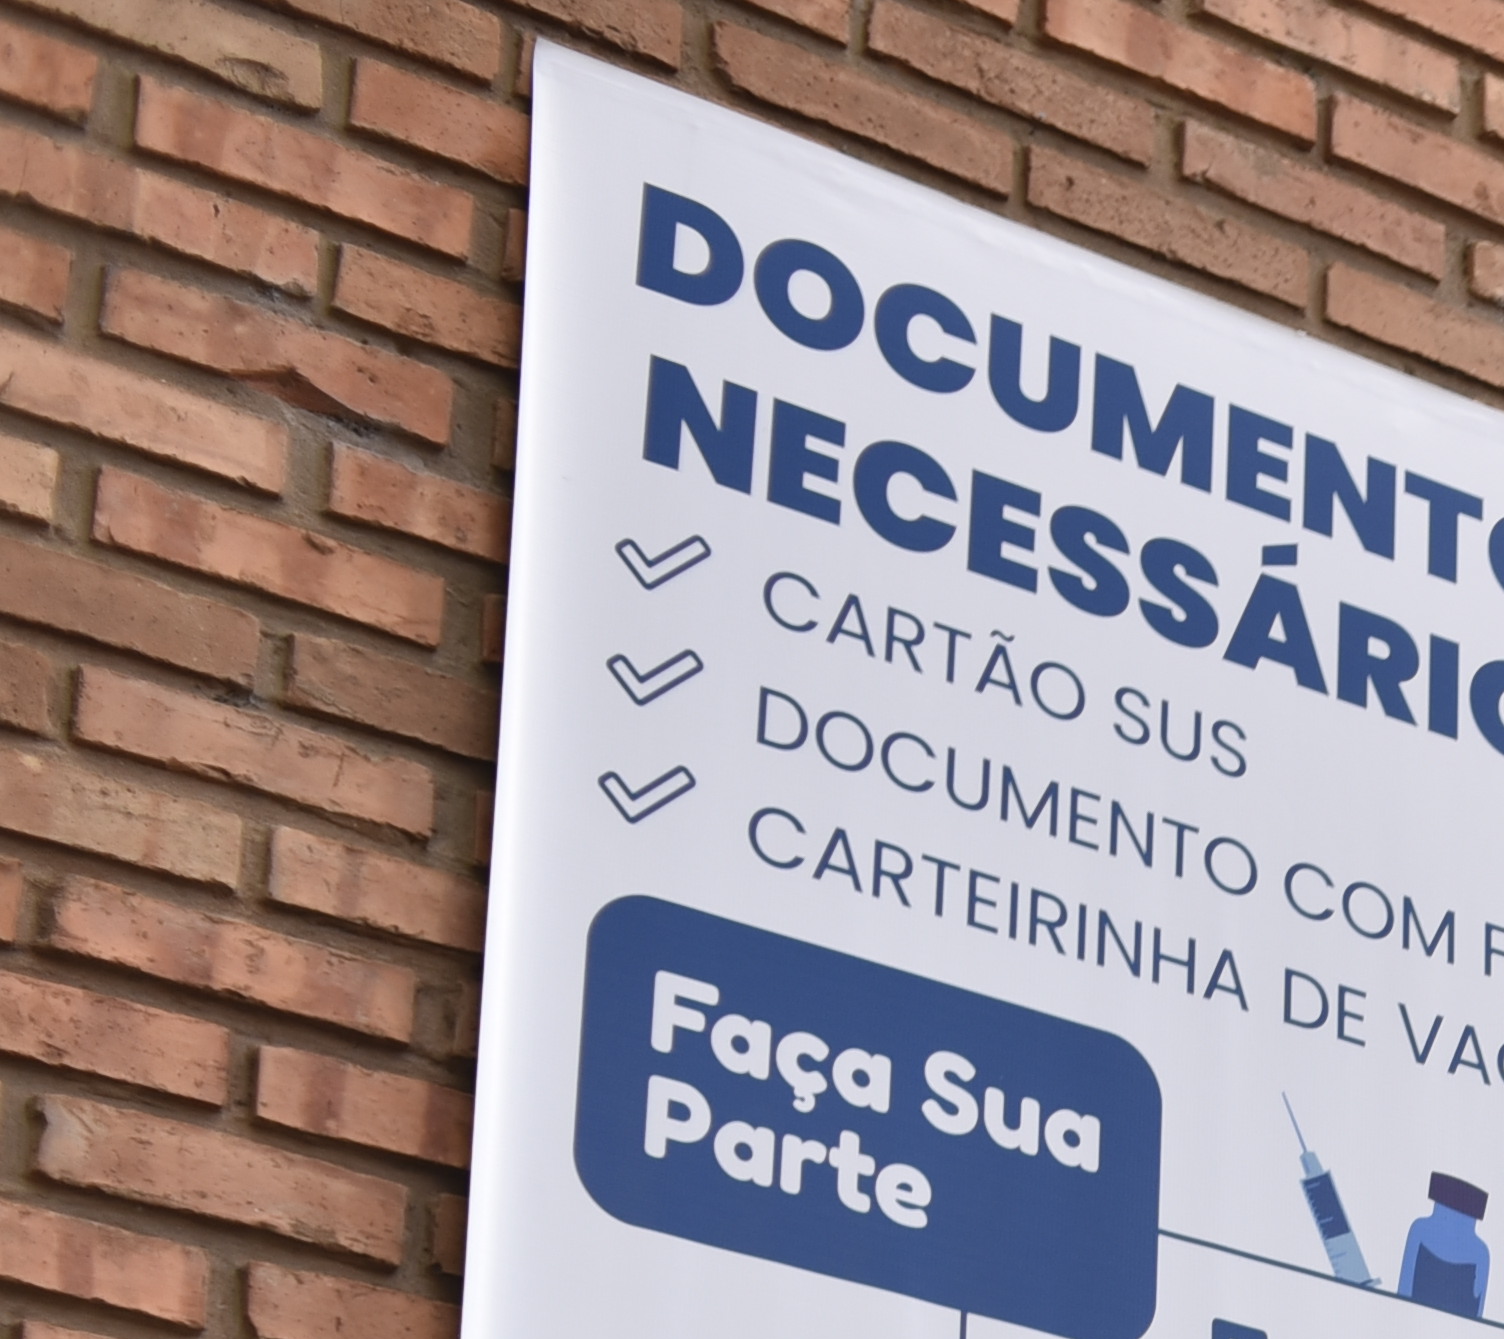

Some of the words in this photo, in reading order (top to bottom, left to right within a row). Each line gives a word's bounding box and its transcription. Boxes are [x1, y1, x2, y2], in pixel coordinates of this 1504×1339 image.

[762, 570, 1087, 723] CARTÃO
[1112, 685, 1249, 778] SUS
[747, 807, 1250, 1012] CARTEIRINHA
[1283, 967, 1368, 1048] DE
[756, 686, 1258, 895] DOCUMENTO
[1283, 862, 1458, 964] COM
[643, 1074, 932, 1230] Parte
[650, 970, 892, 1114] Faça
[922, 1050, 1101, 1174] Sua
